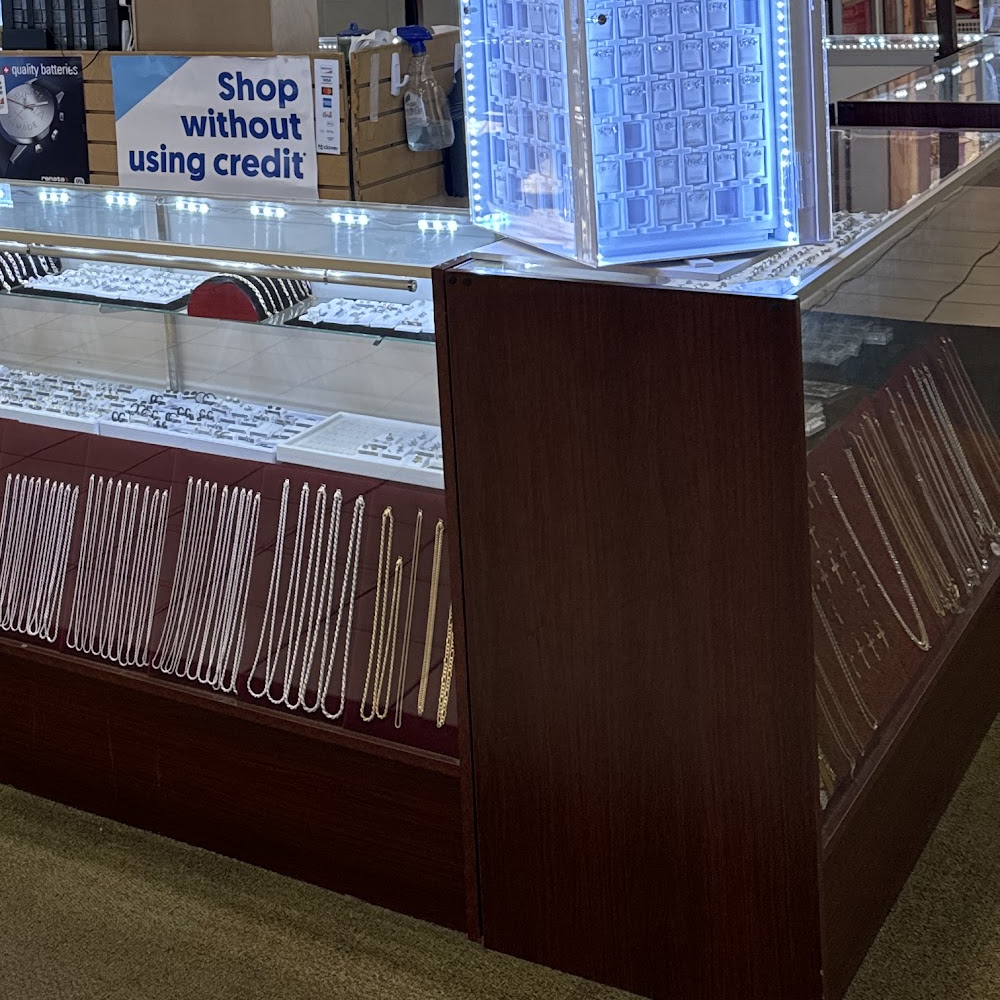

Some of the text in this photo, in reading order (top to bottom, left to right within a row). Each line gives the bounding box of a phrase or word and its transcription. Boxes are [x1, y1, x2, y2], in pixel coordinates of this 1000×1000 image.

[11, 63, 39, 78] quality
[40, 63, 79, 76] batteries
[218, 71, 299, 109] Shop
[181, 108, 302, 140] without
[129, 143, 304, 181] using credit
